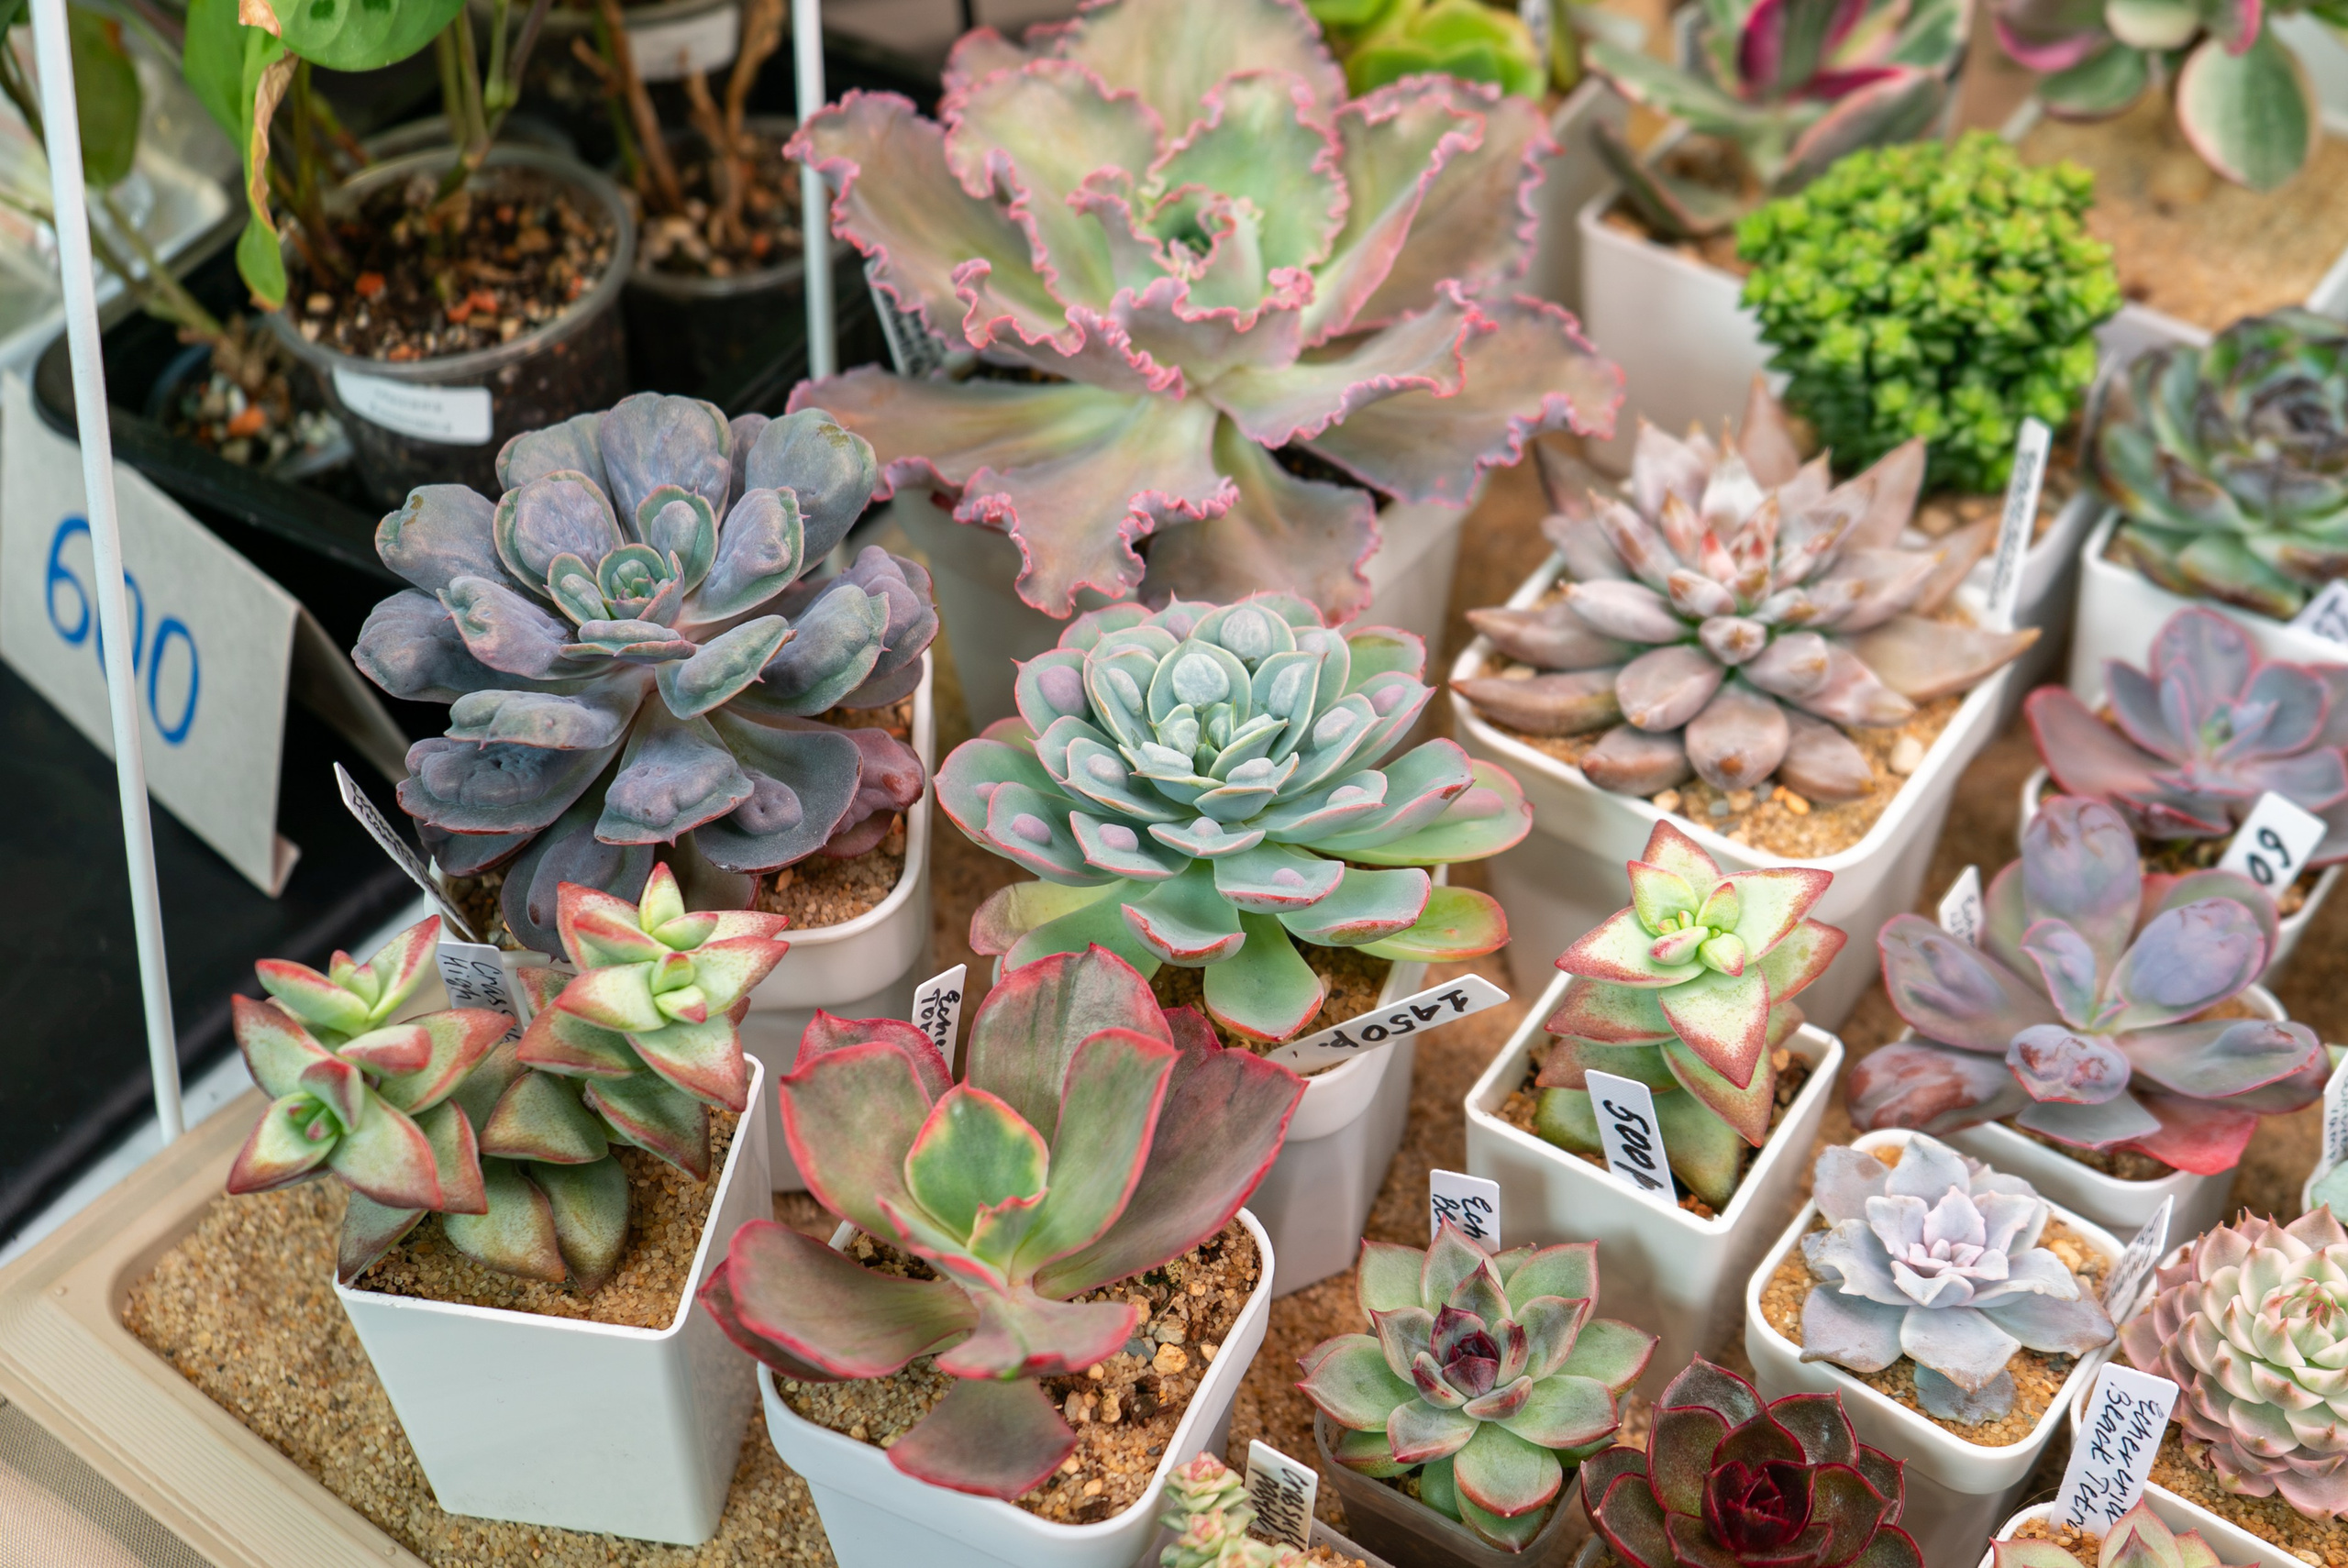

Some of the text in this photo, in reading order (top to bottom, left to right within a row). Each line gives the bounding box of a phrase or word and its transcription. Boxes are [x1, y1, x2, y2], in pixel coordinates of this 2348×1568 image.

[44, 513, 200, 746] 600
[440, 954, 482, 1000] High
[935, 990, 960, 1055] Eche
[1461, 1196, 1493, 1241] Ech
